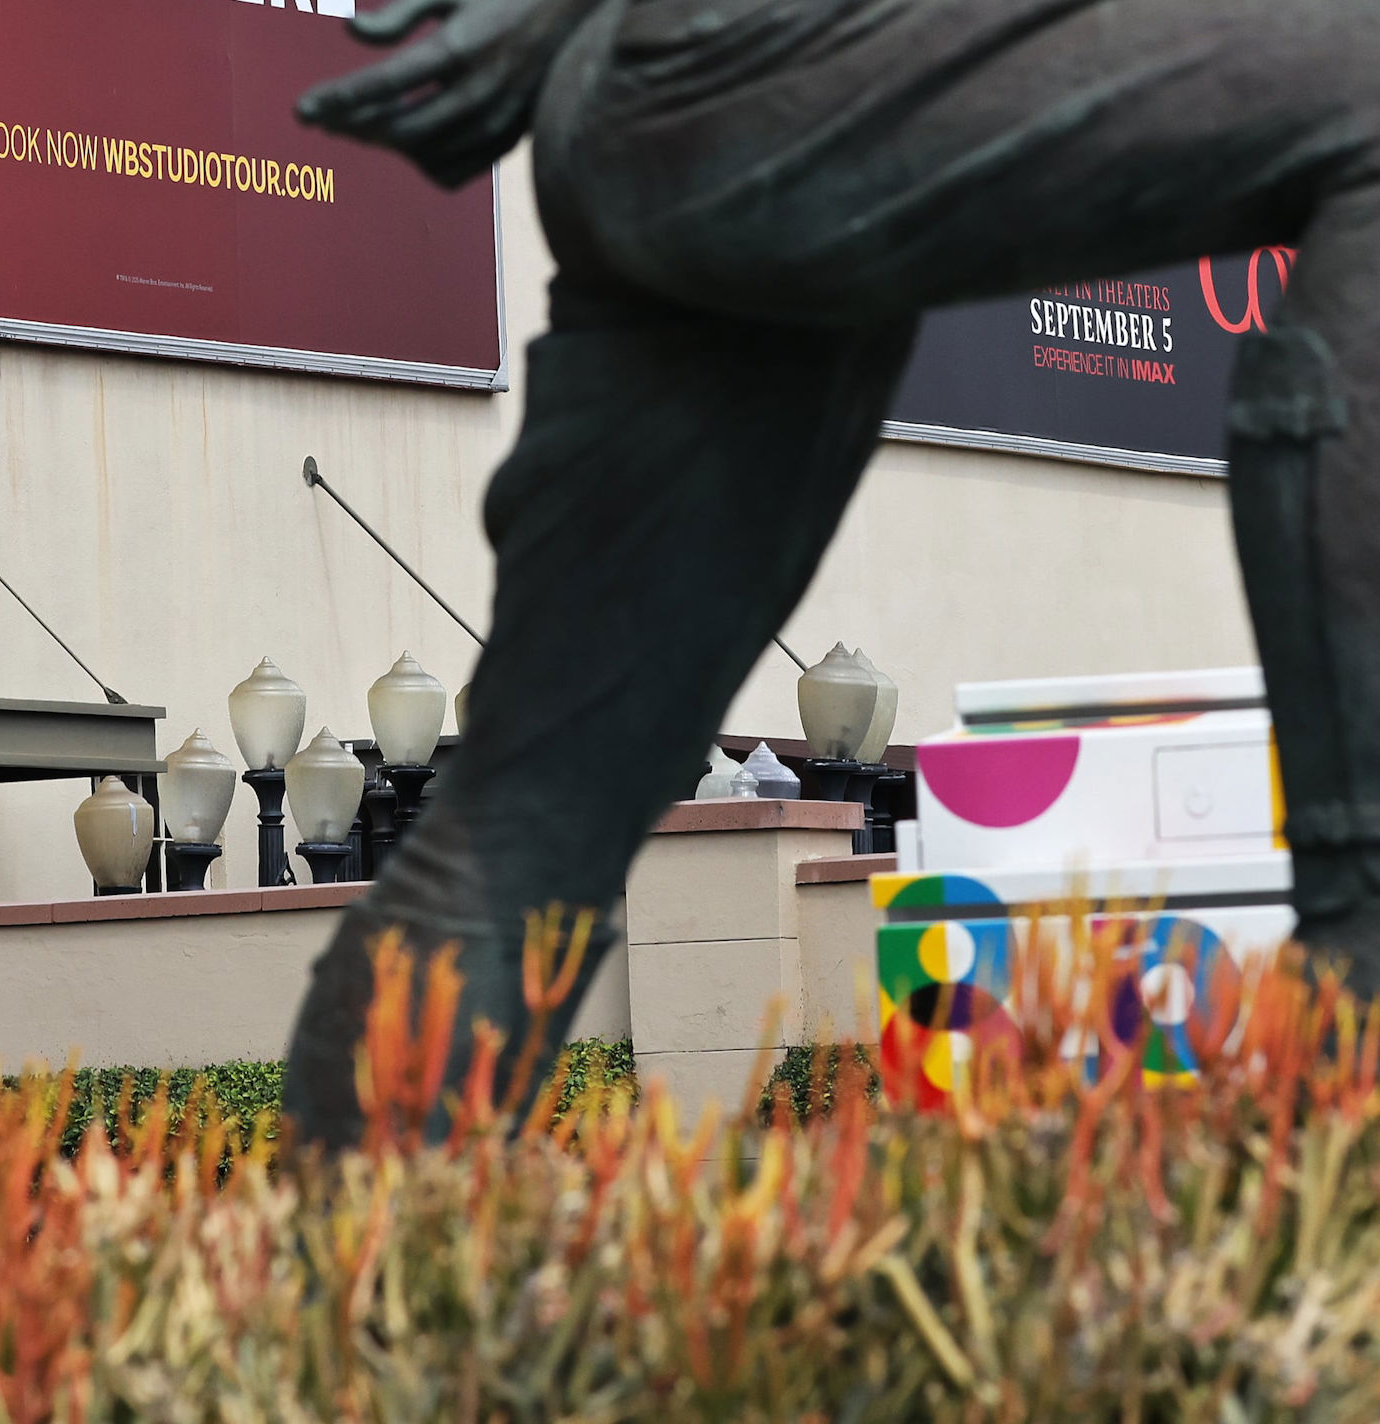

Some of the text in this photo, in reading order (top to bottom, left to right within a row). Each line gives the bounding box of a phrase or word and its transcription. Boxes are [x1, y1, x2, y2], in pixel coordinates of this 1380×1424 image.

[46, 128, 98, 171] NOW
[102, 136, 335, 204] WBSTUDIOTOUR.COM
[1097, 279, 1170, 312] THEATERS
[1030, 298, 1173, 352] SEPTEMBER 5
[1033, 345, 1176, 384] EXPERIENCE IT IN IMAX
